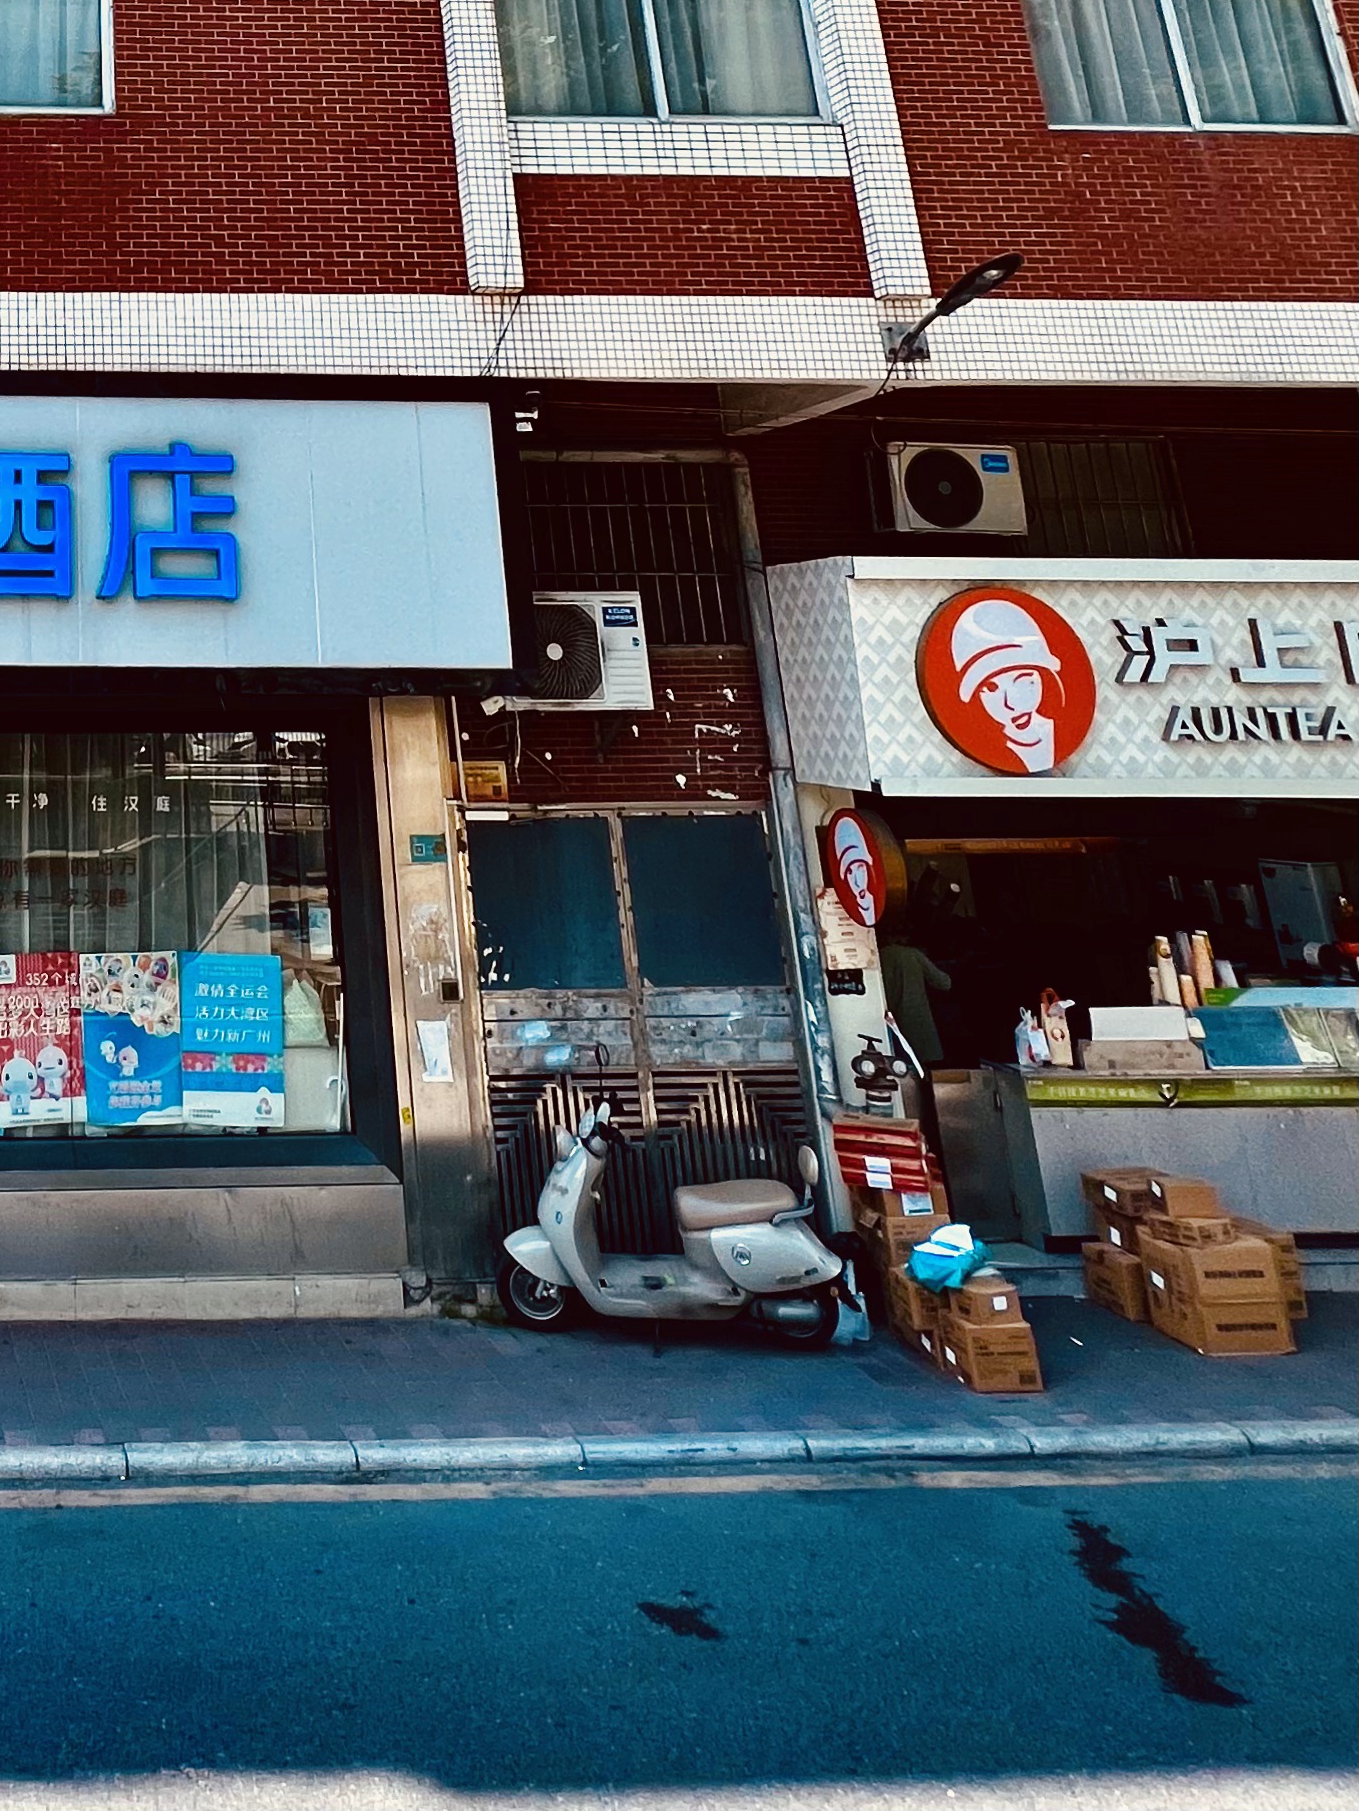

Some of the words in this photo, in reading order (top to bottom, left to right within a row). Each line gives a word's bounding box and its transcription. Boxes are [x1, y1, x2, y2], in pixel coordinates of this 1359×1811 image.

[1112, 617, 1359, 685] 沪上
[1163, 705, 1357, 743] AUNTEA
[91, 794, 171, 813] 住汉庭
[194, 982, 270, 1000] 激情全运会
[194, 1005, 270, 1021] 活力大湾区
[195, 1028, 272, 1044] 魅力新广州
